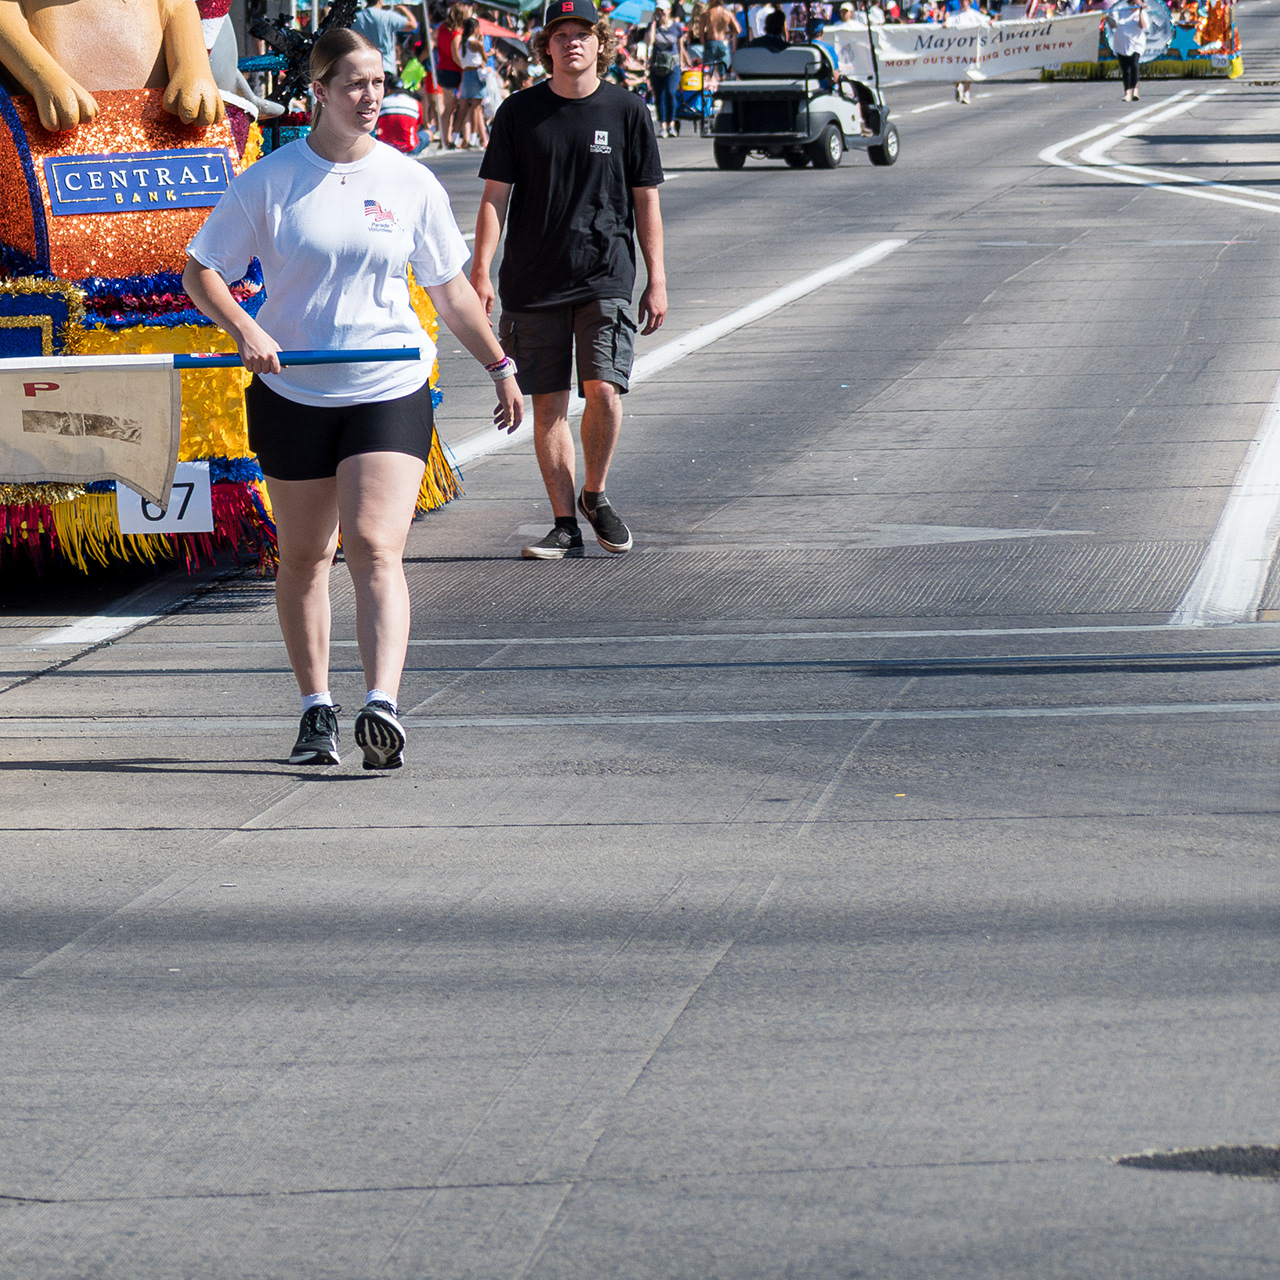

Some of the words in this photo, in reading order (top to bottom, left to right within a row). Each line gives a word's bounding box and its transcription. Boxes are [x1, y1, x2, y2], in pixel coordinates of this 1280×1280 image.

[914, 33, 988, 52] Mayors
[991, 24, 1053, 45] Award
[885, 57, 918, 68] MOST
[922, 51, 1000, 65] OUTSTANING
[1004, 44, 1030, 58] CITY
[1035, 41, 1074, 53] ENTRY
[64, 165, 219, 192] CENTRAL
[115, 189, 177, 205] BANK
